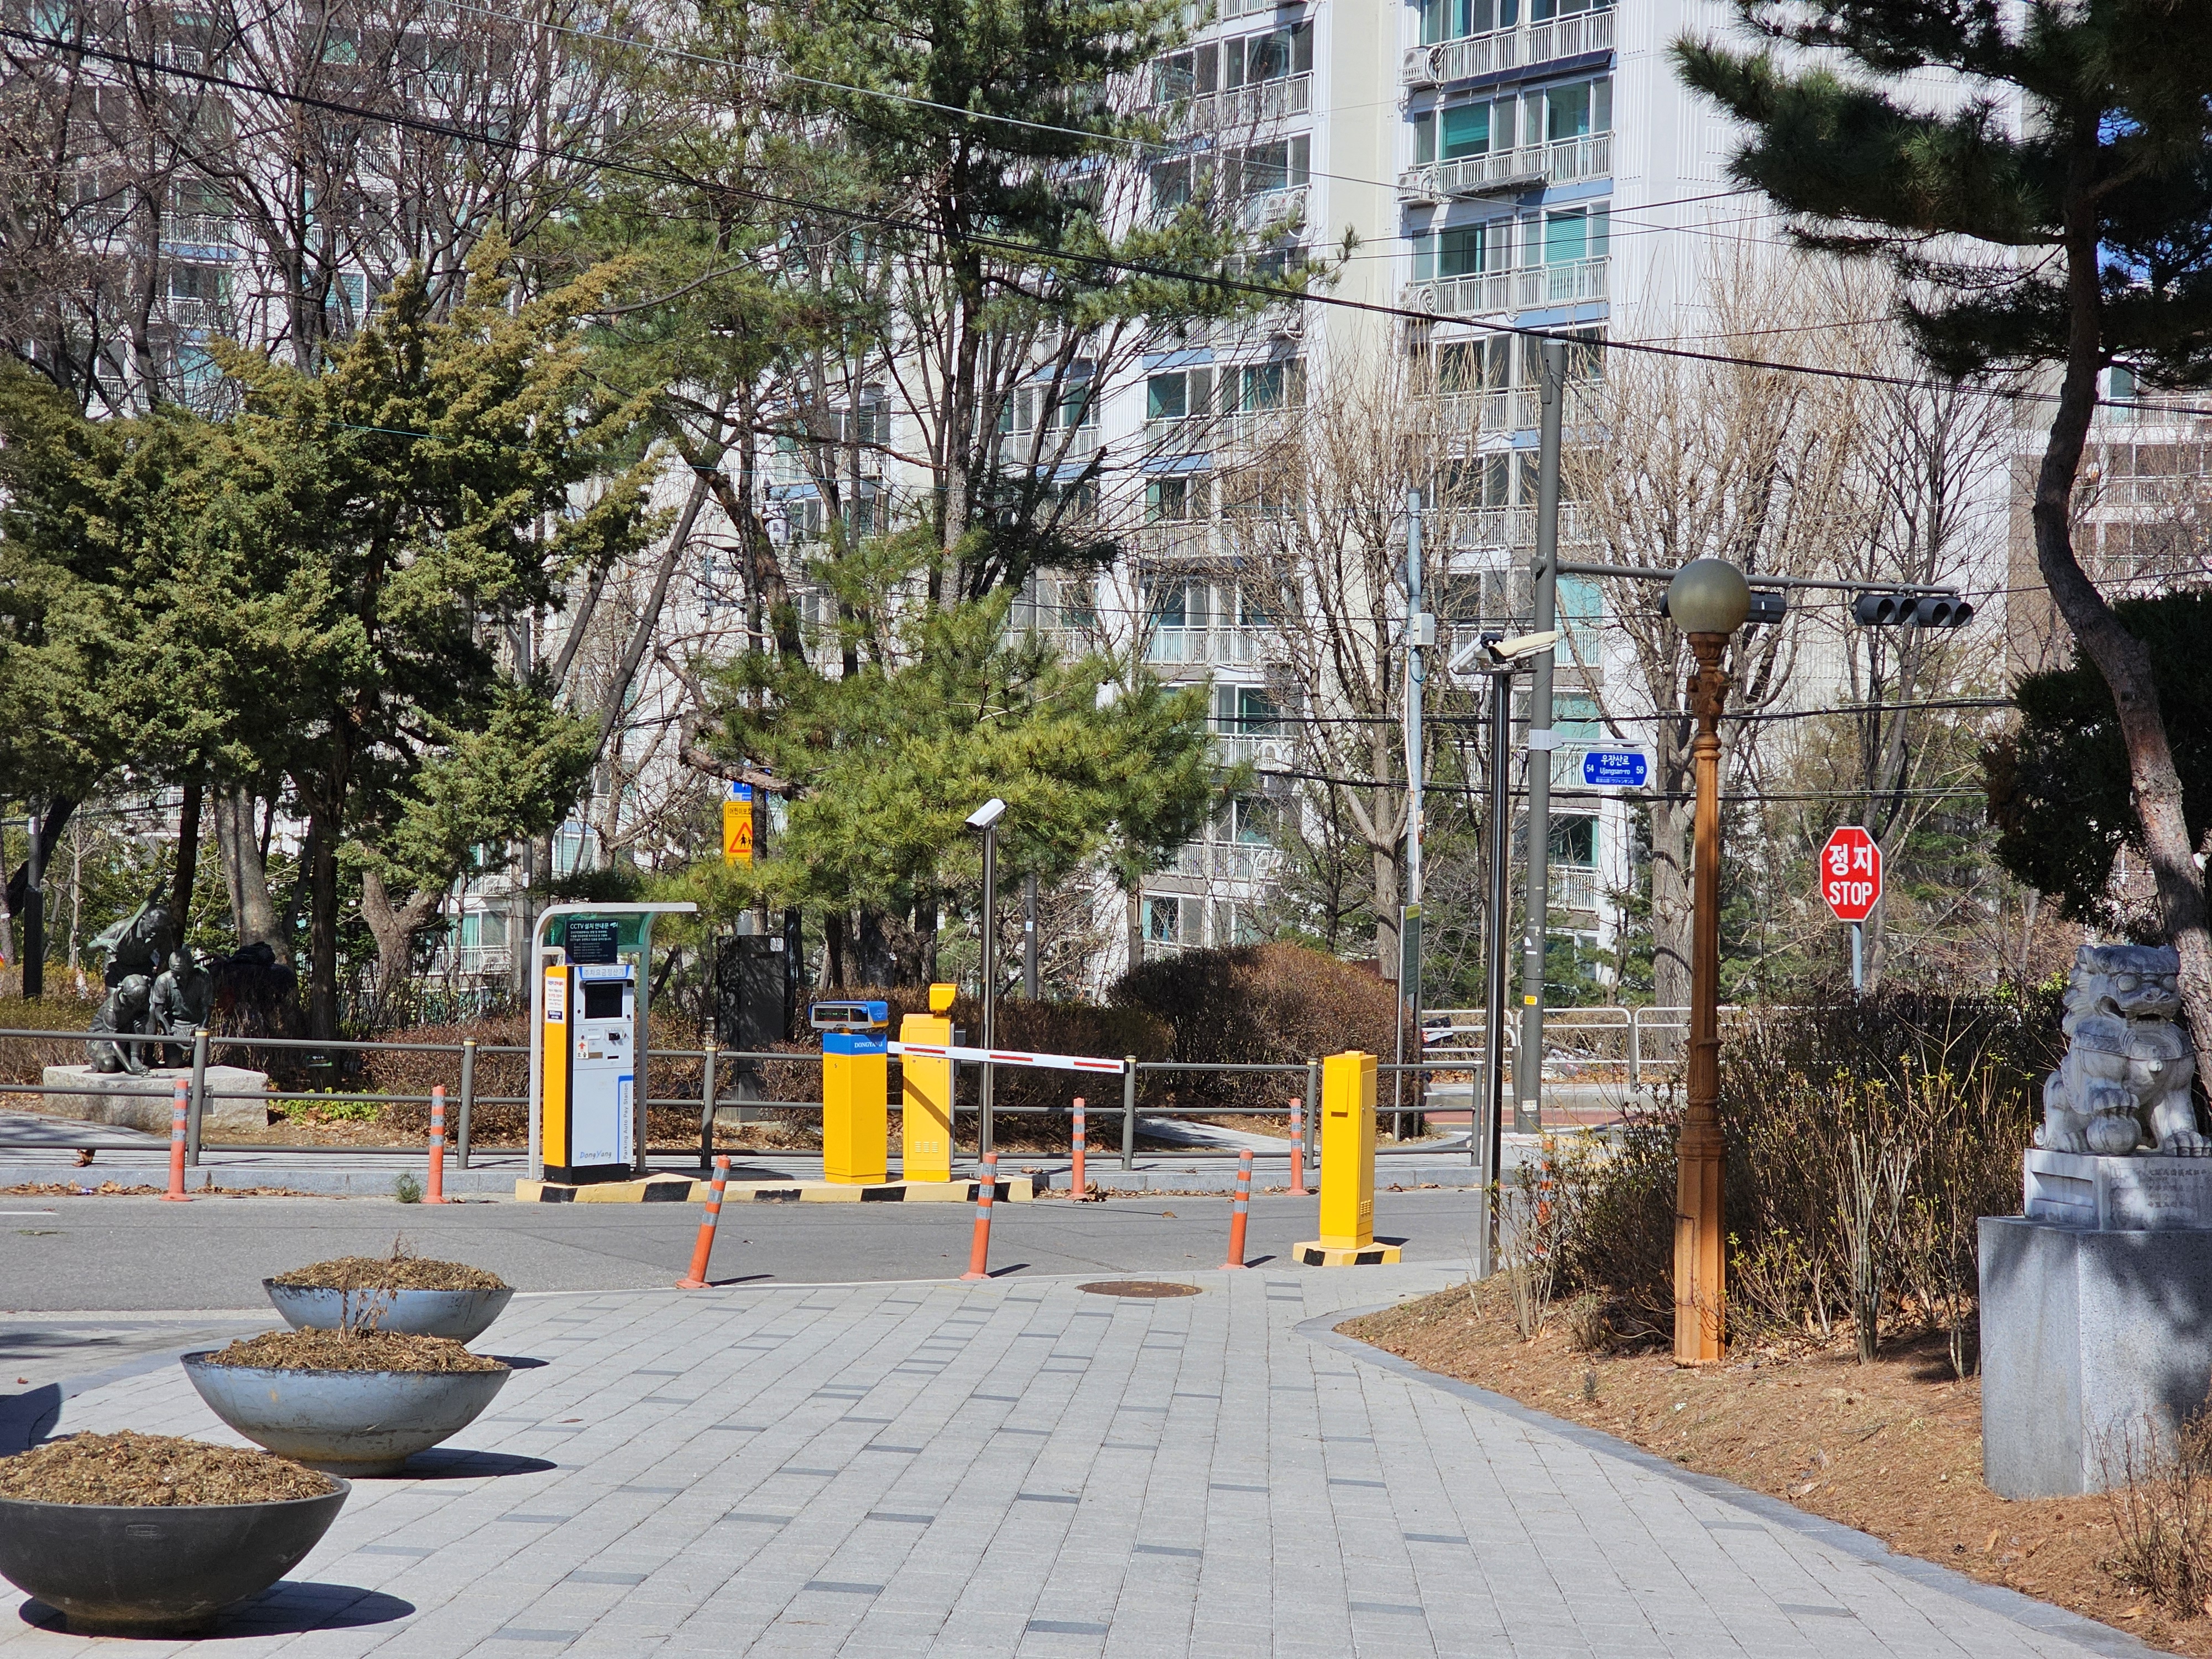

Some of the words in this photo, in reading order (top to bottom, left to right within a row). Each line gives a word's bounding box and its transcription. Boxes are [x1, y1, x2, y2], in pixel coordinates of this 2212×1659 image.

[1587, 764, 1594, 773] 54
[1600, 767, 1631, 775] Ujangsan-ro
[1636, 766, 1644, 774] 58
[1828, 843, 1872, 877] 정지
[1829, 881, 1873, 906] STOP
[584, 968, 624, 977] 주차요금정산기
[580, 1150, 612, 1160] DongYang
